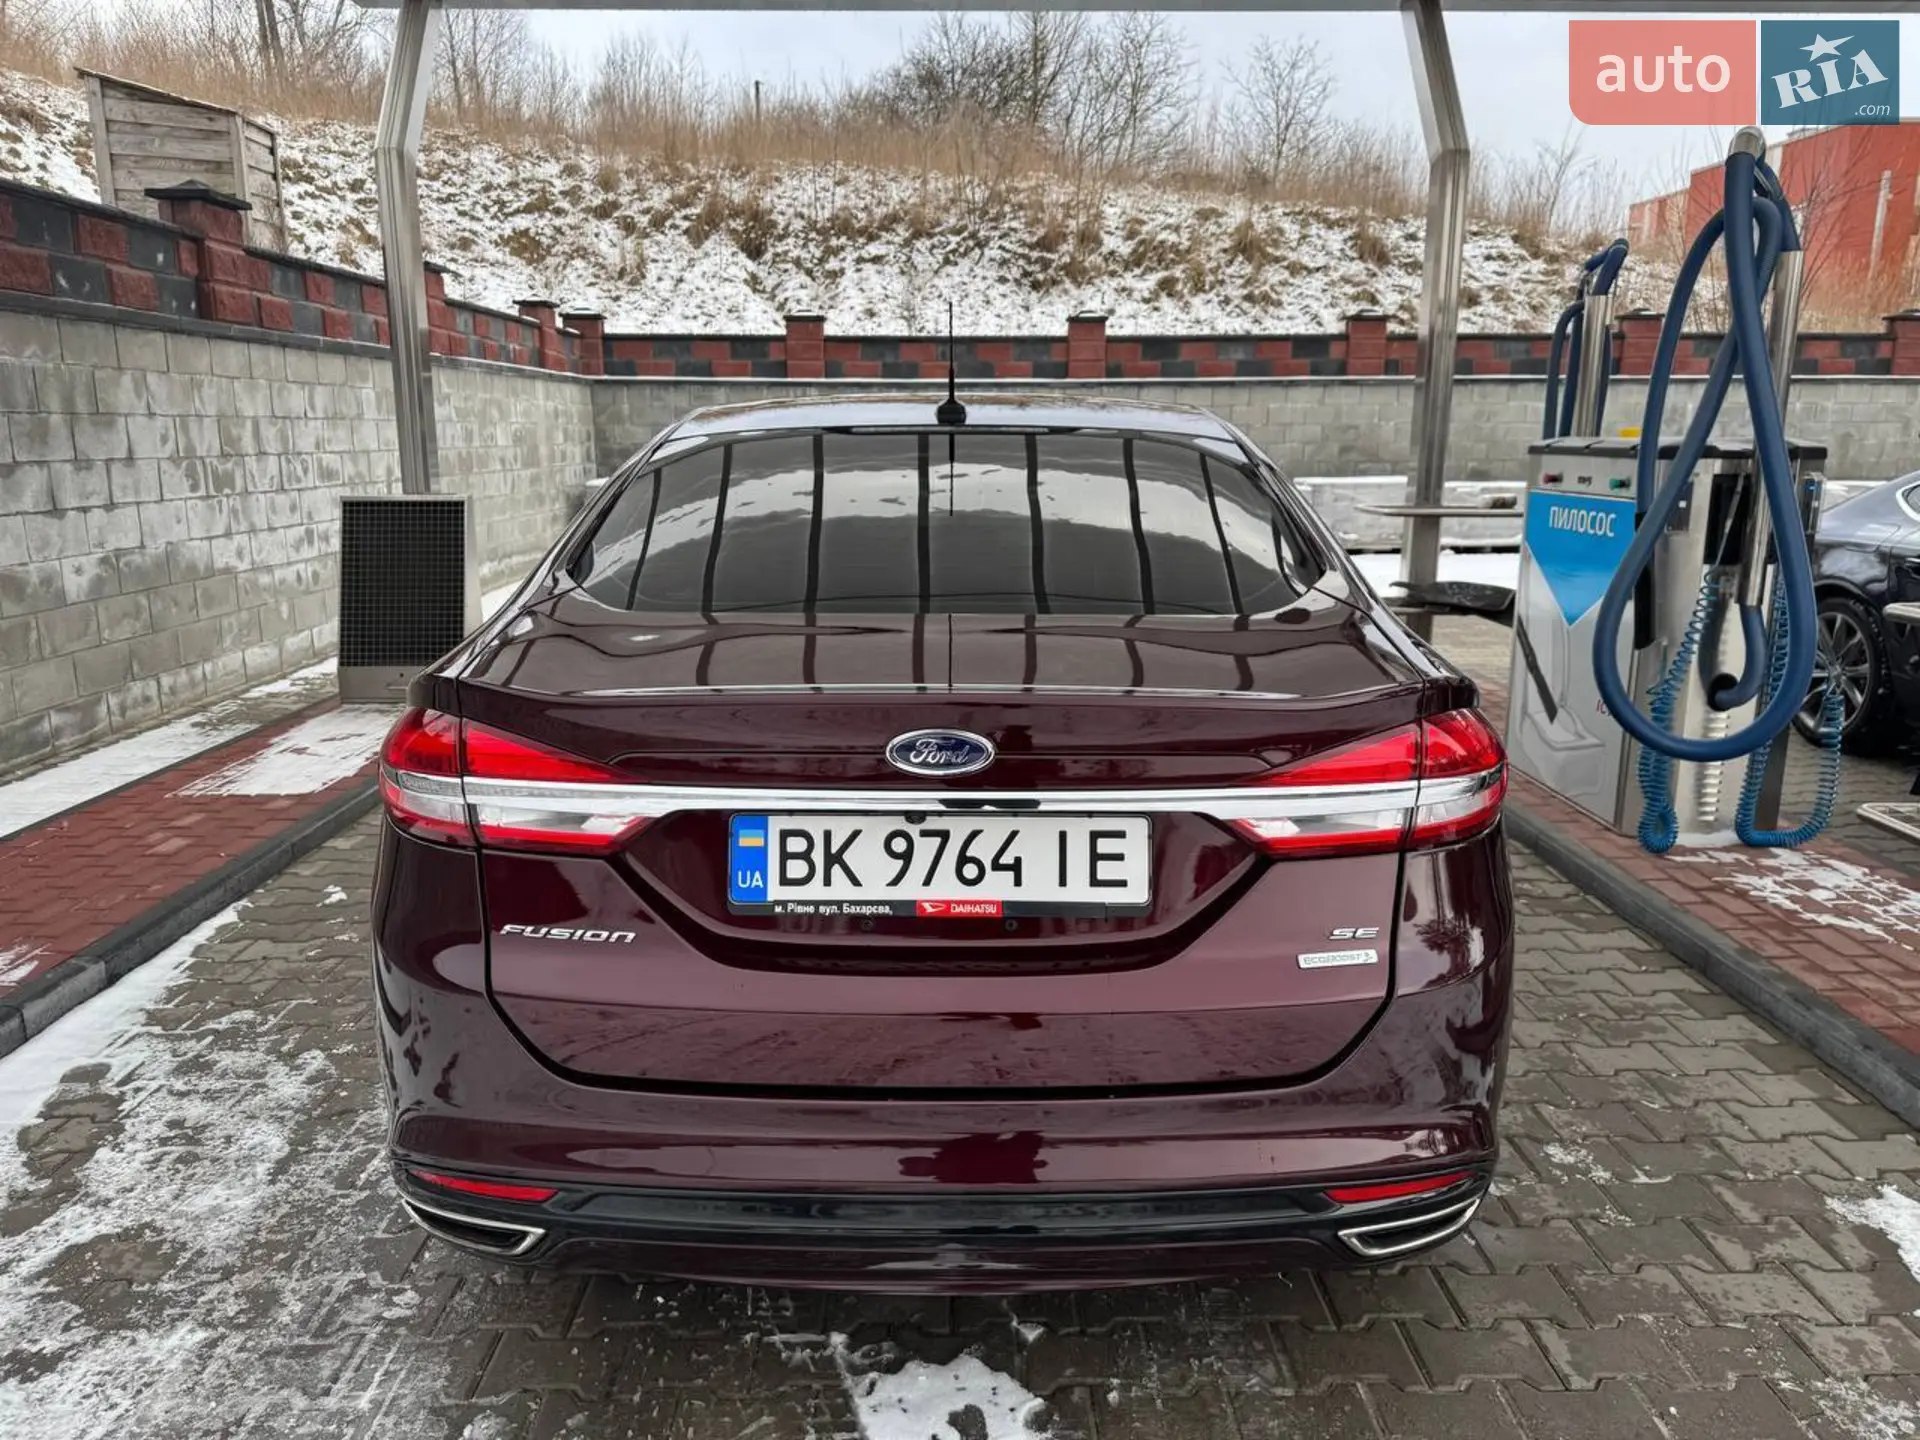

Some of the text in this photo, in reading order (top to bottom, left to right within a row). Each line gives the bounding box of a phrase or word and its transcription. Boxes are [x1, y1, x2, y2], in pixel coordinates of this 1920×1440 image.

[1548, 505, 1617, 537] ПИЛОСОС
[909, 738, 970, 764] Ford
[778, 829, 1128, 887] BK 9764 IE
[737, 870, 764, 889] UA
[819, 904, 841, 916] вул.
[950, 904, 997, 914] DAIHATSU
[500, 924, 637, 943] FUSION
[1329, 927, 1380, 940] SE
